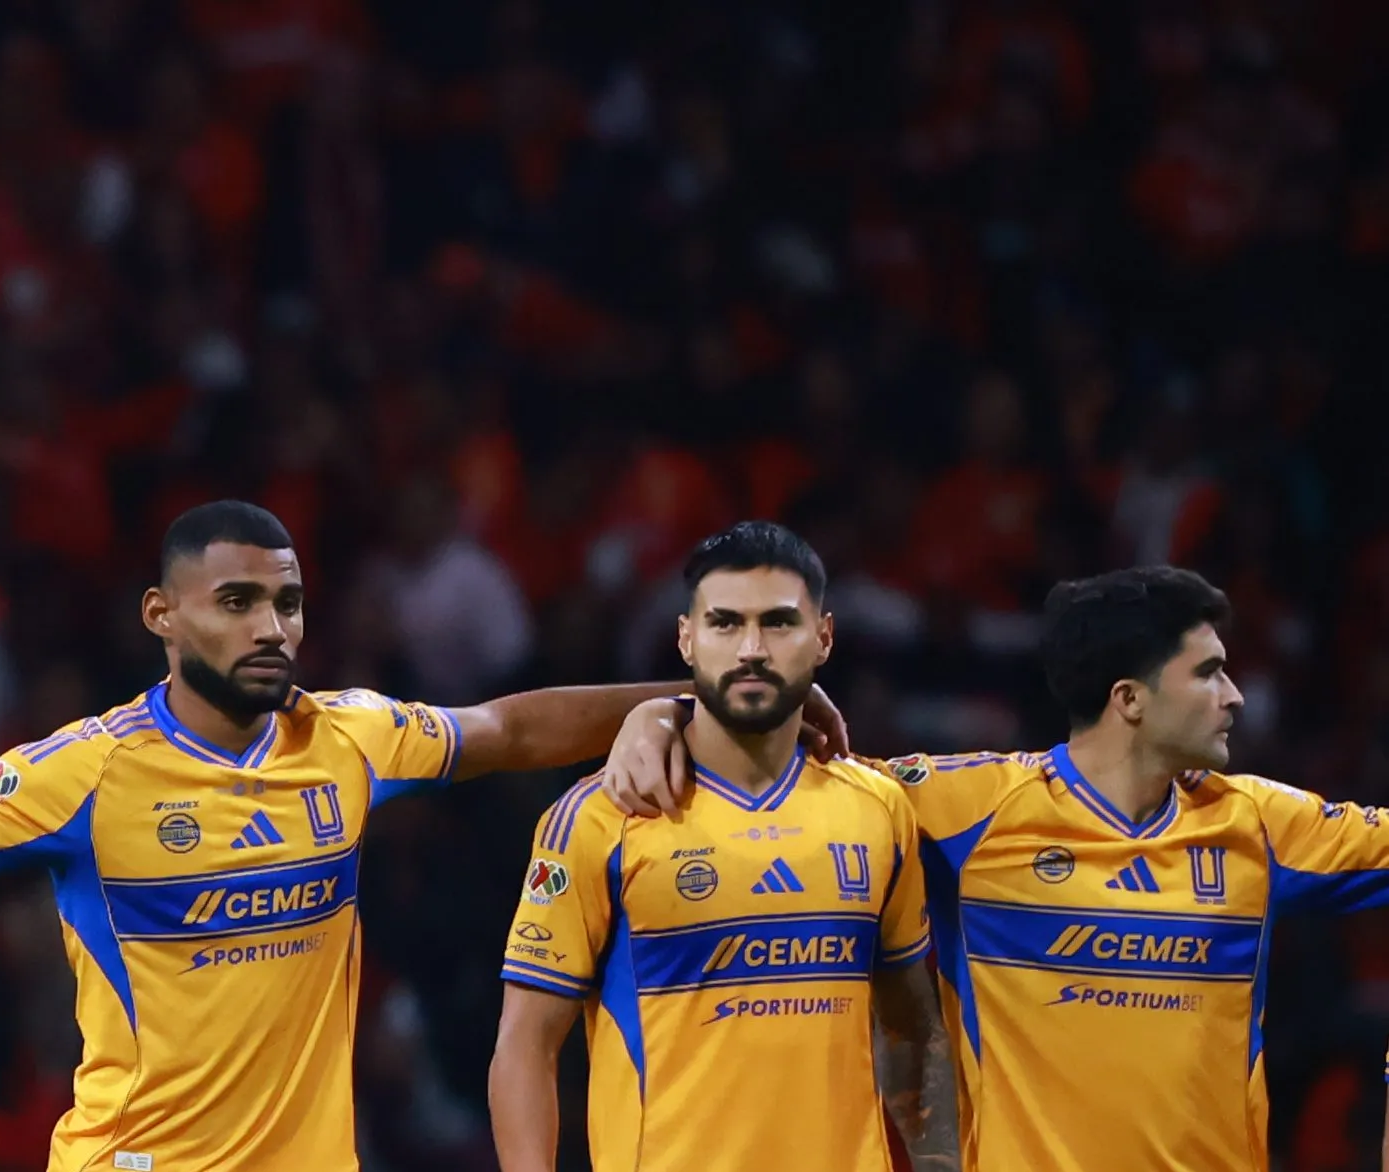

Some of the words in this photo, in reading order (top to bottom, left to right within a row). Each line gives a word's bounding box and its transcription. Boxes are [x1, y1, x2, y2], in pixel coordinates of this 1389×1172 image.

[225, 877, 338, 920] CEMEX
[744, 936, 857, 968] CEMEX
[1092, 931, 1212, 964] CEMEX
